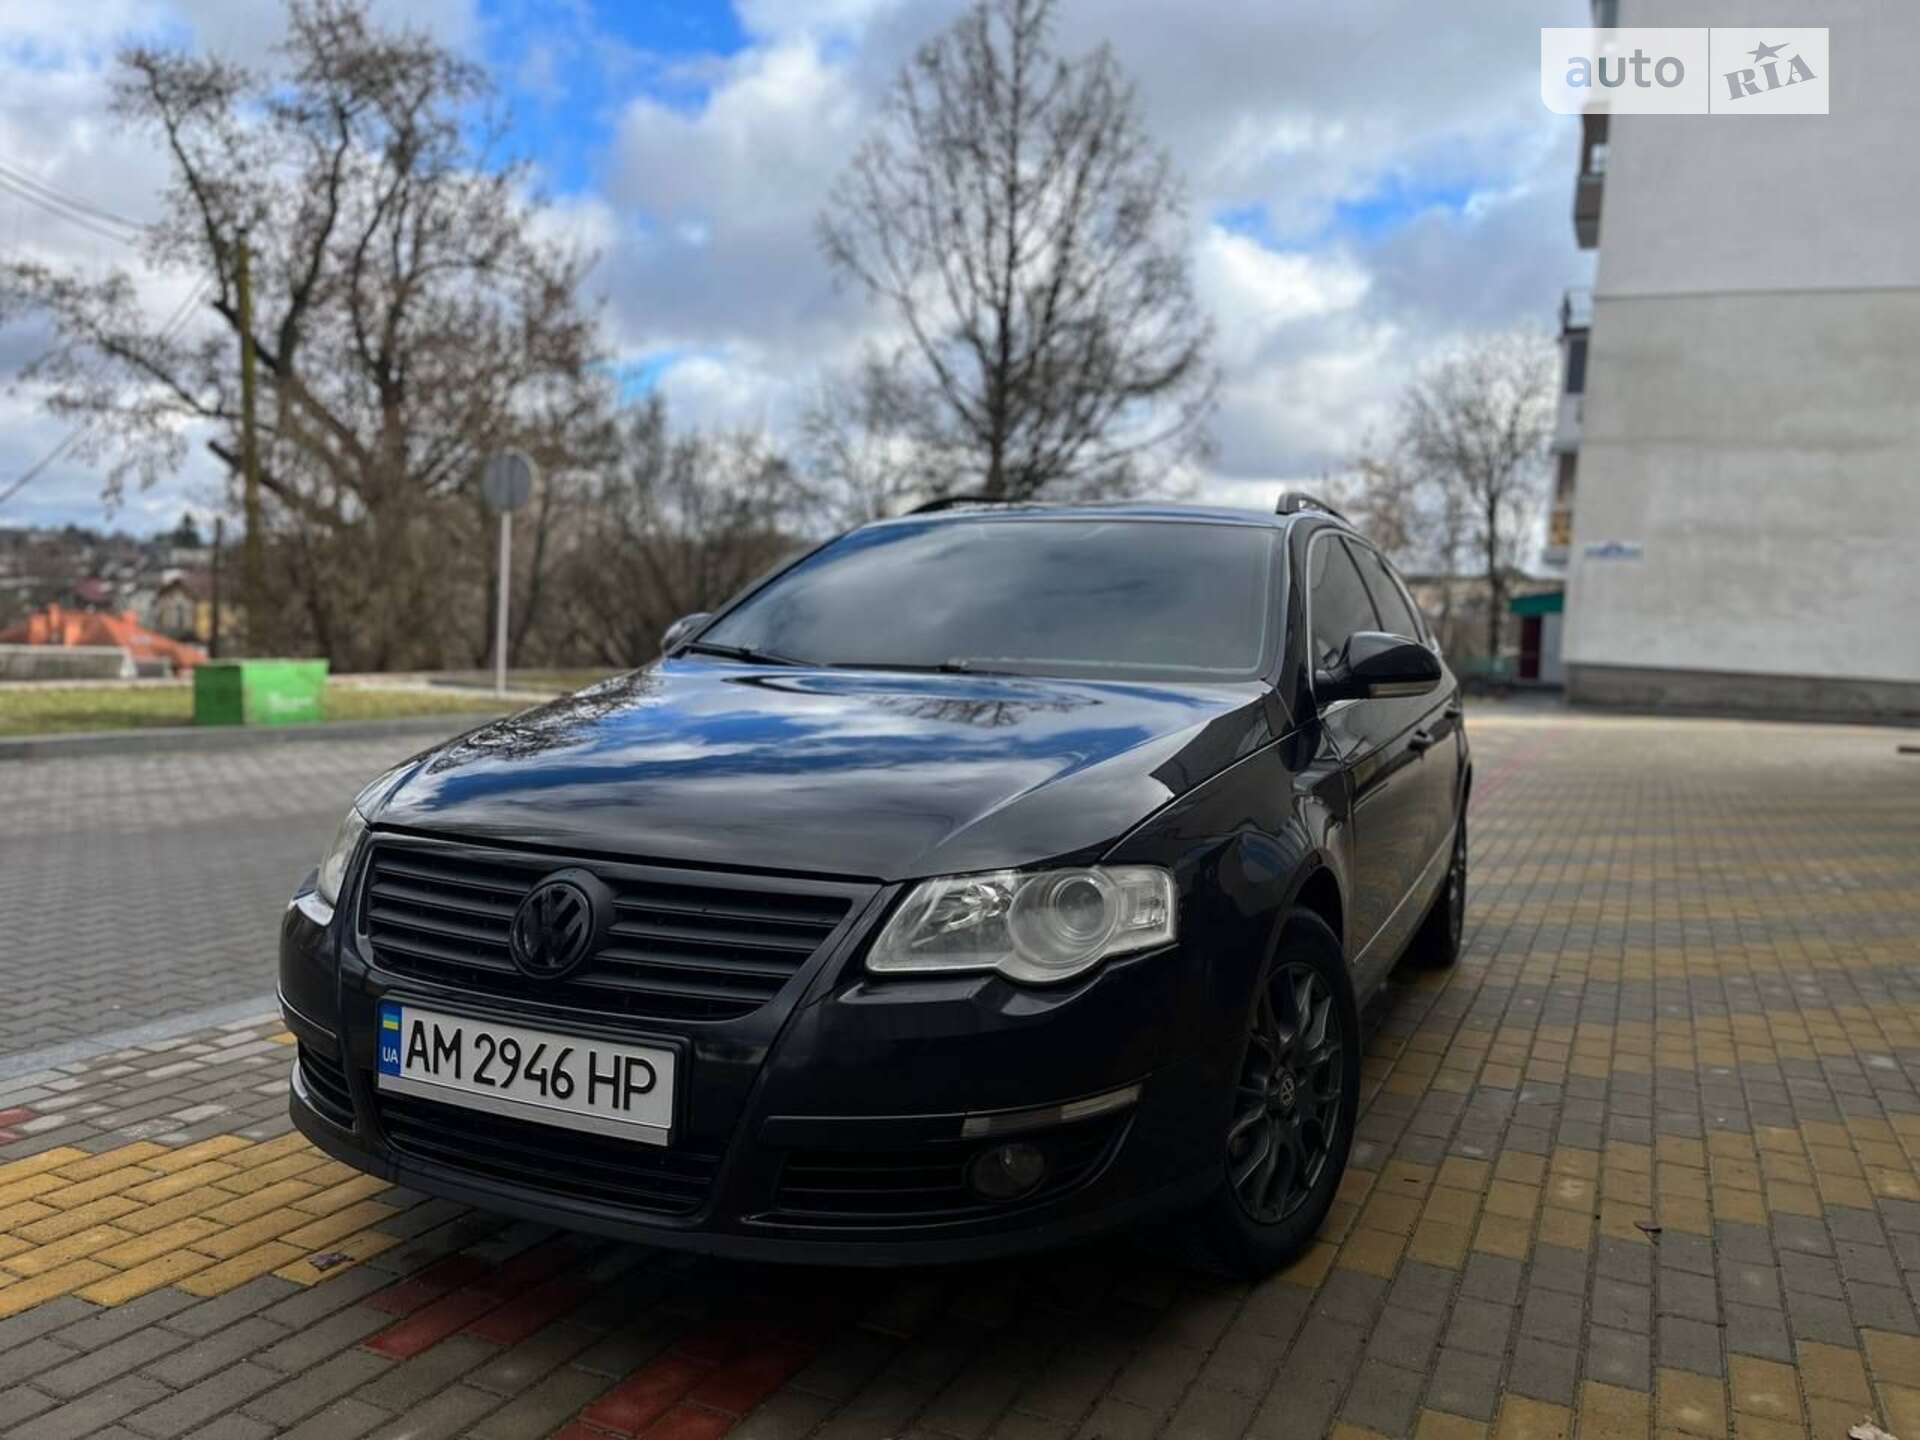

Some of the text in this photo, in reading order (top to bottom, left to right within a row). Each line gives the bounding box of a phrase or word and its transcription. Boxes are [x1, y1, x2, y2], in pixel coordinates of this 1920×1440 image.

[382, 1046, 399, 1064] UA
[405, 1019, 657, 1111] AM 2946 HP
